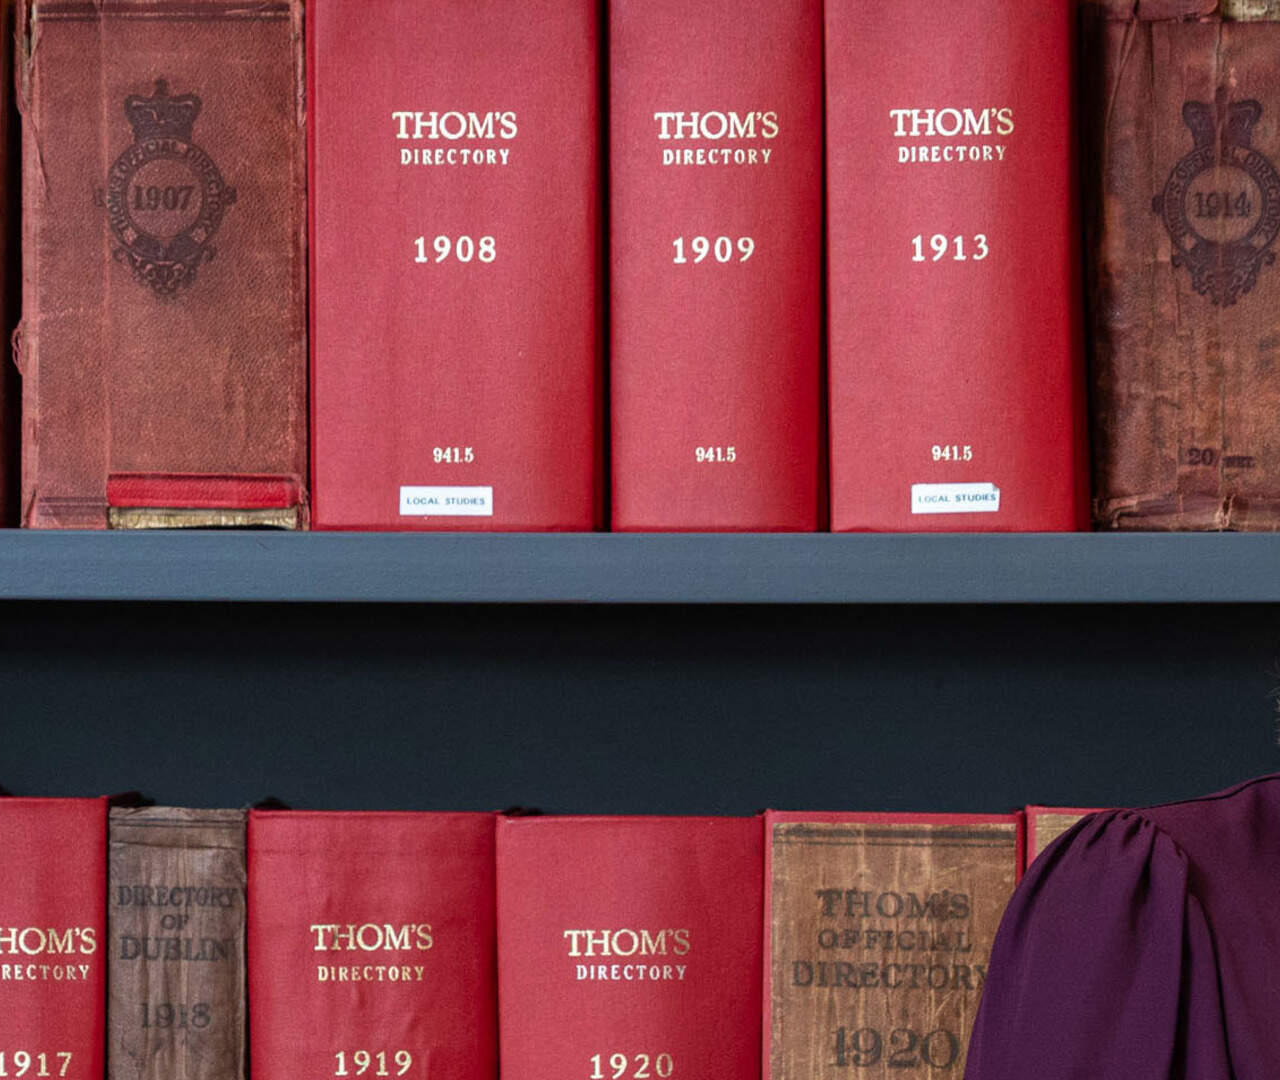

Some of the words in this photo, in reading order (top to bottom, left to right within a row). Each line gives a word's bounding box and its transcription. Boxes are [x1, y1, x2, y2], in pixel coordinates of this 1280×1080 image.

[392, 112, 517, 139] THOM'S
[654, 111, 778, 139] THOM'S
[890, 108, 1013, 136] THOM'S
[401, 149, 509, 165] DIRECTORY
[663, 149, 771, 165] DIRECTORY
[898, 145, 1004, 163] DIRECTORY
[133, 184, 193, 212] 1907
[1194, 192, 1251, 218] 1914
[415, 236, 496, 263] 1908
[673, 236, 754, 263] 1909
[912, 234, 988, 261] 1913
[433, 447, 474, 463] 941.5
[696, 447, 736, 462] 941.5
[932, 445, 972, 461] 941.5
[406, 496, 439, 507] LOCAL
[445, 496, 486, 507] STUDIES
[919, 493, 950, 504] LOCAL
[955, 492, 996, 502] STUDIES
[119, 886, 235, 907] DIRECTORY
[817, 889, 971, 921] THOM'S
[161, 913, 188, 930] OF
[120, 937, 230, 961] DUBLIN
[310, 924, 432, 951] THOM'S
[564, 929, 691, 956] THOM'S
[818, 927, 971, 953] OFFICIAL
[317, 966, 423, 981] DIRECTORY
[576, 965, 685, 980] DIRECTORY
[829, 1026, 959, 1069] 1920
[335, 1051, 411, 1076] 1919
[590, 1053, 672, 1079] 1920
